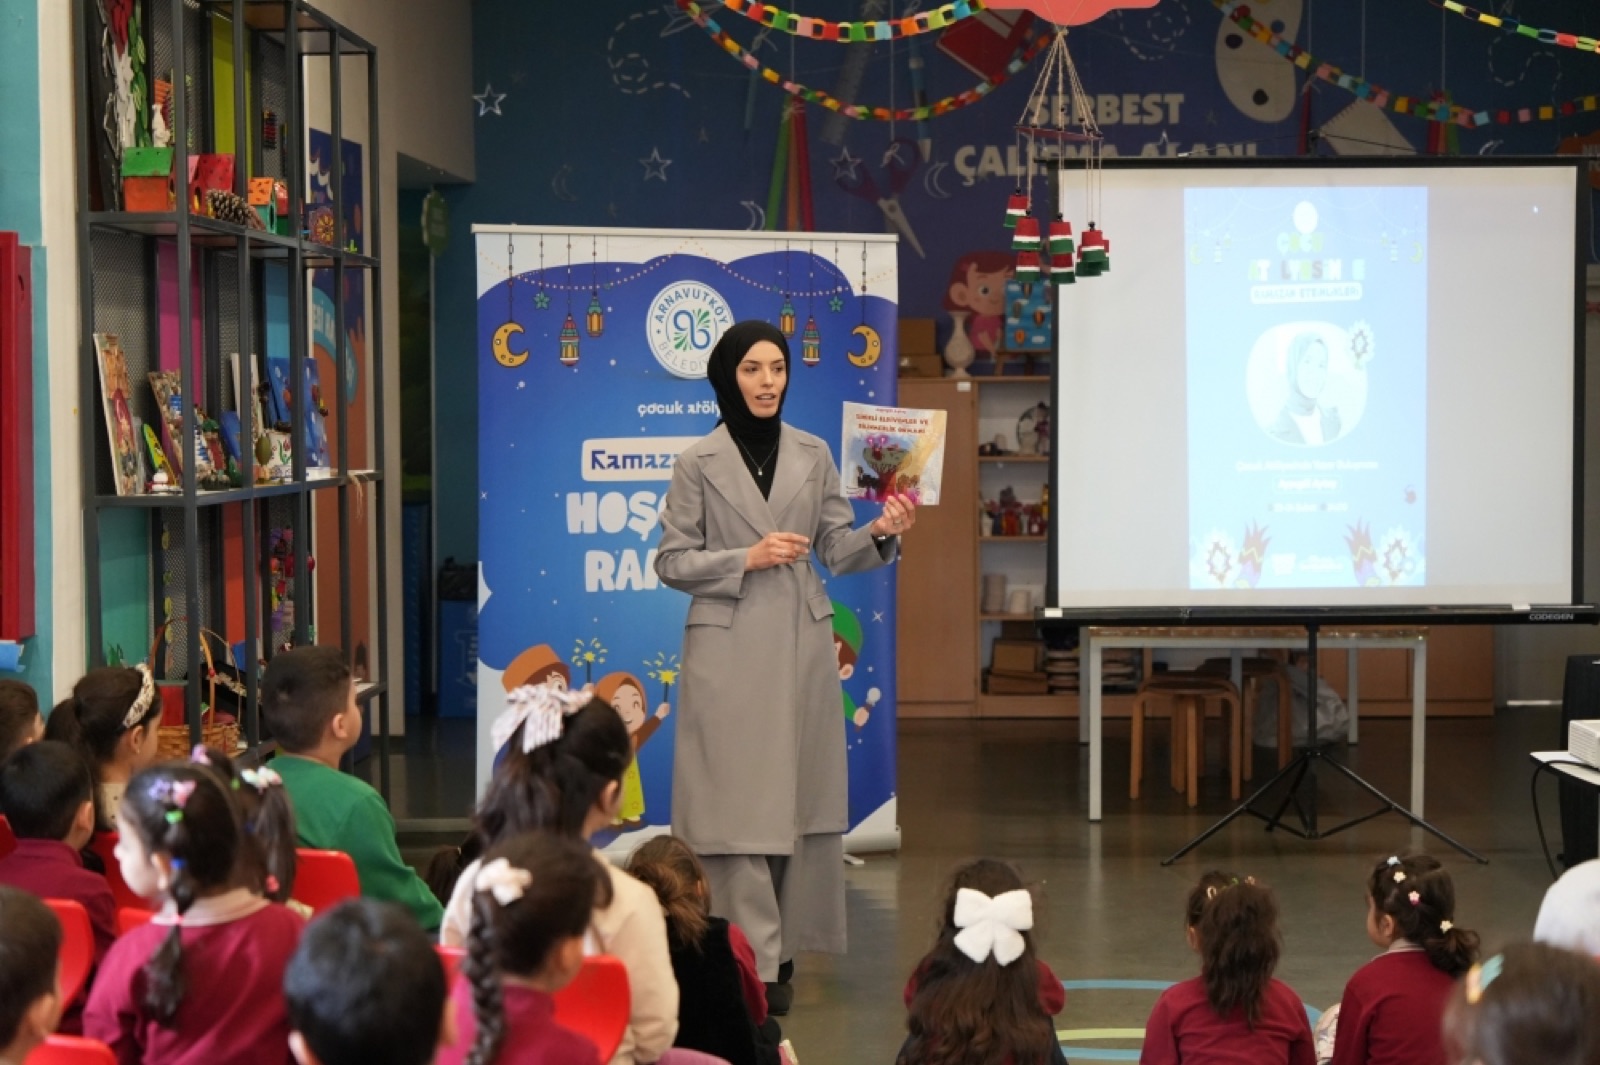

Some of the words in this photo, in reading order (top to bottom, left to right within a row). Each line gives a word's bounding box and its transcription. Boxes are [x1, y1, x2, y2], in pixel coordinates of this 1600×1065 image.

[1027, 93, 1184, 125] SERBEST
[591, 449, 677, 471] Ramaz
[566, 490, 668, 542] HOŞ
